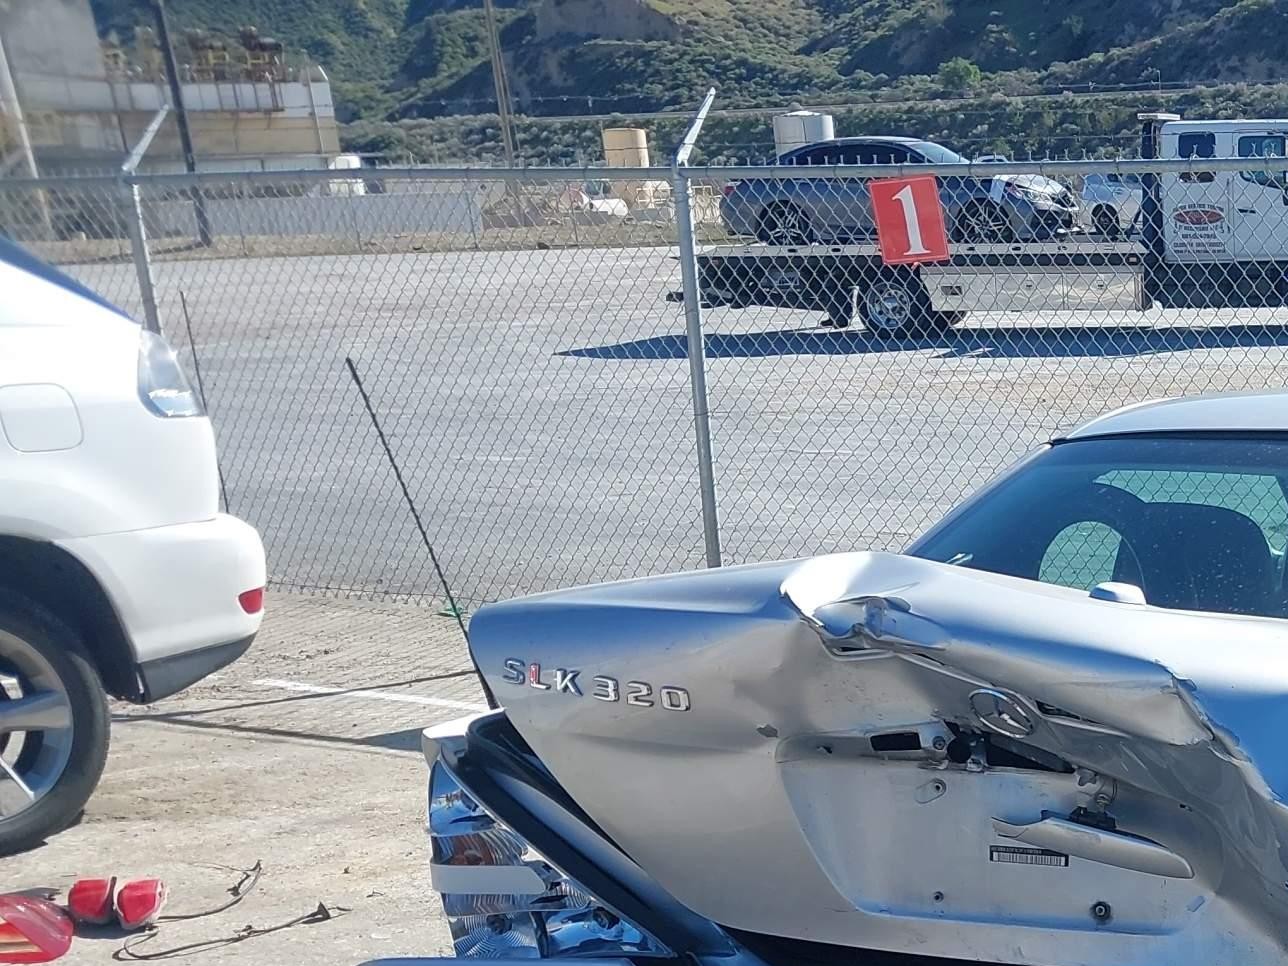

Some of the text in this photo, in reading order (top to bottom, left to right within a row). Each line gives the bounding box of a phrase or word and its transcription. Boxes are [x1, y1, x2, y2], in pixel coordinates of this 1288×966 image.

[891, 184, 931, 256] 1
[502, 656, 692, 712] SLK 320
